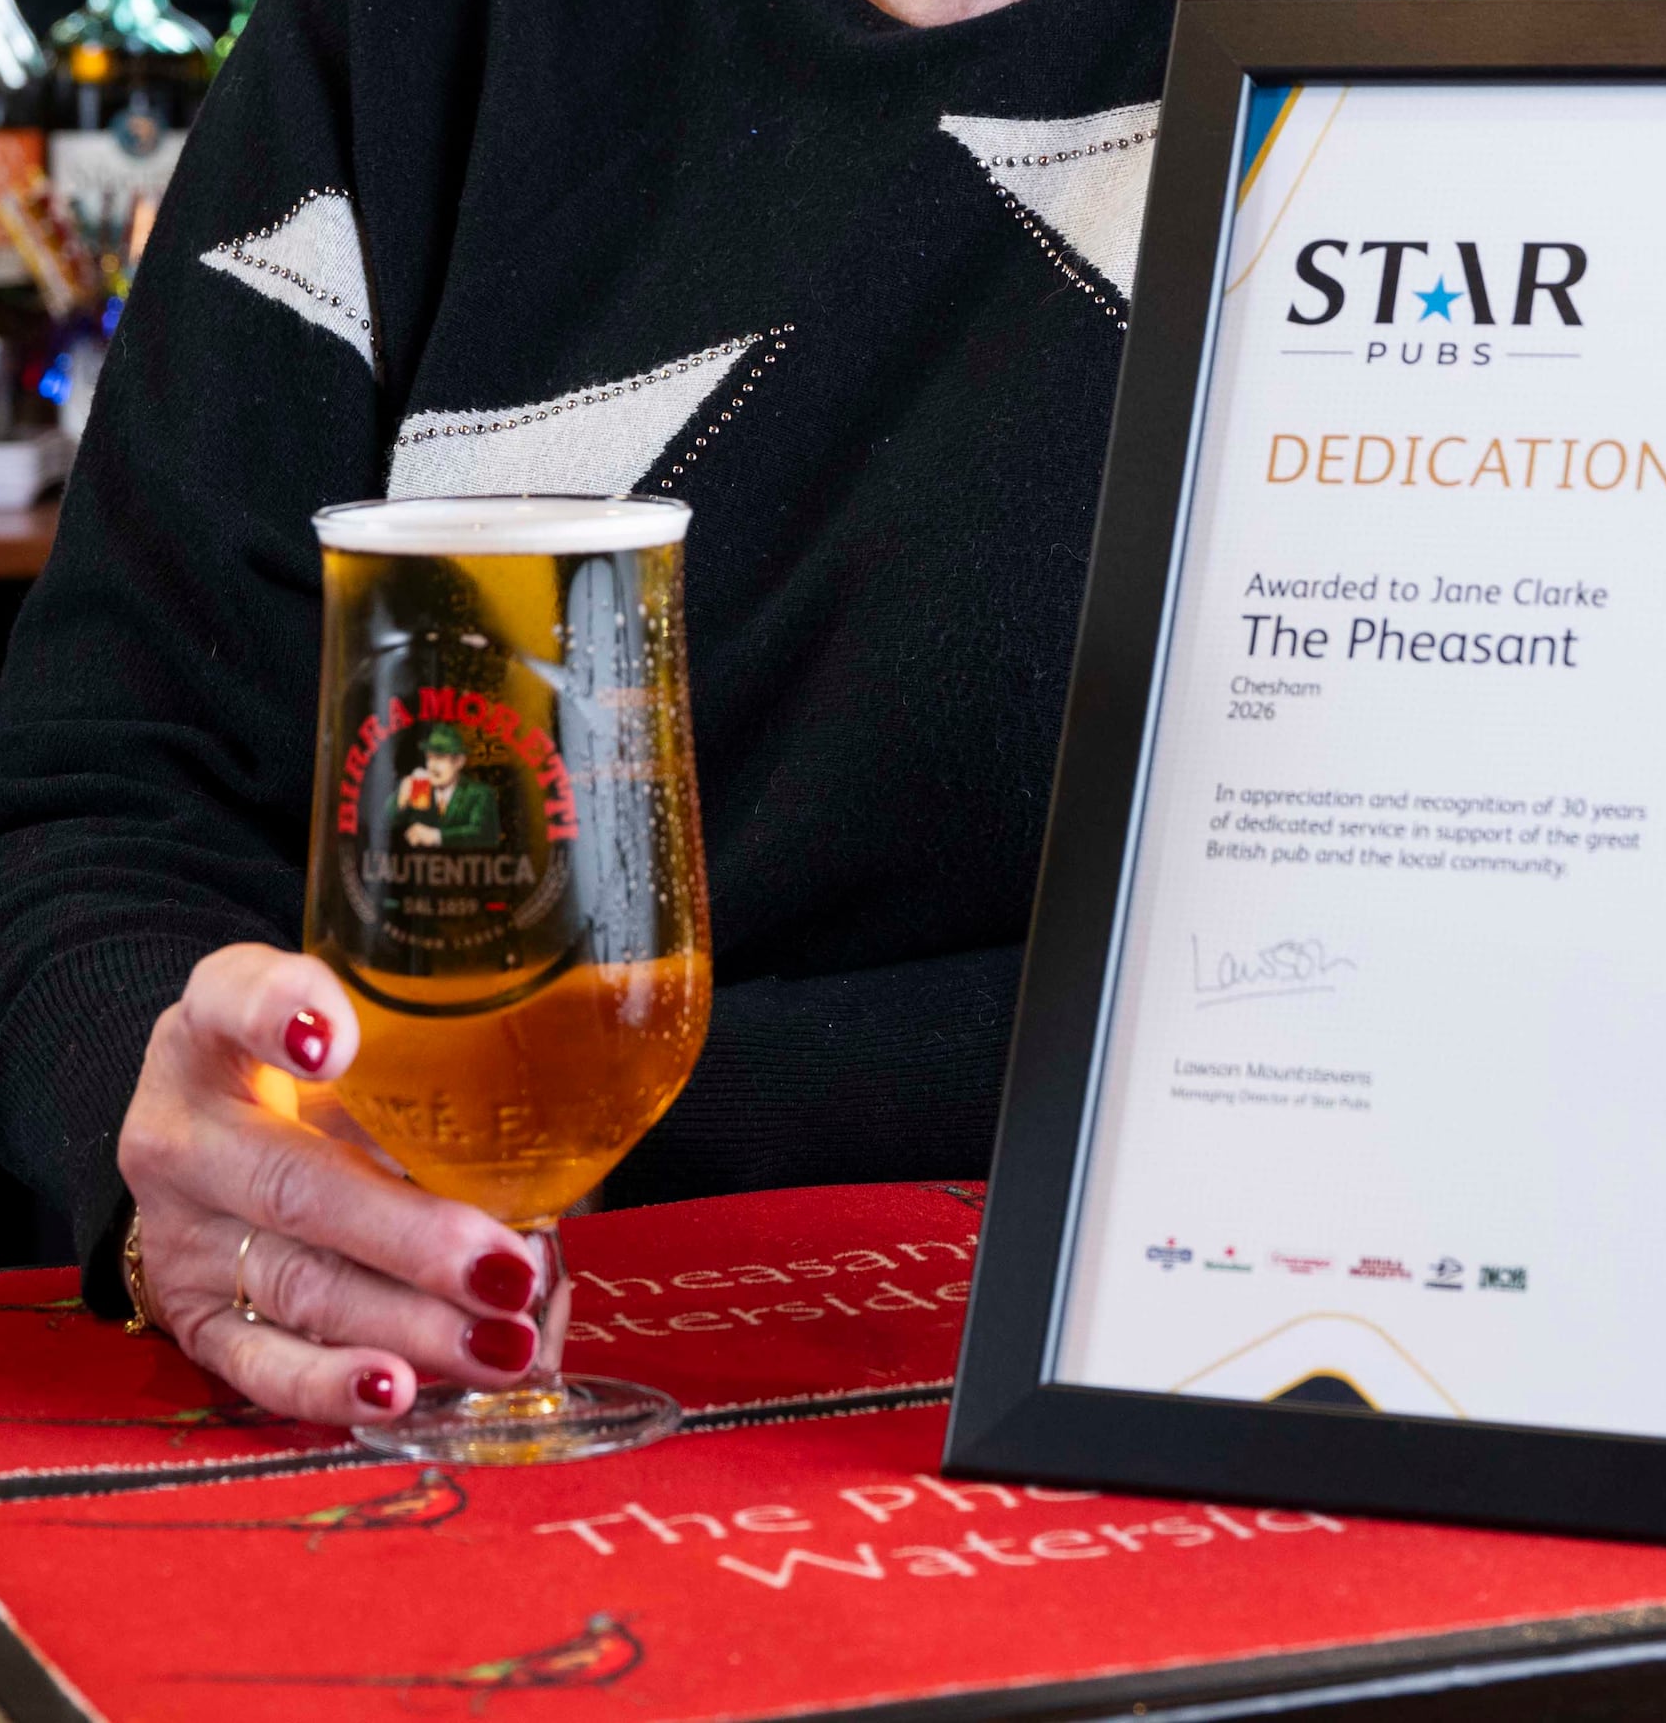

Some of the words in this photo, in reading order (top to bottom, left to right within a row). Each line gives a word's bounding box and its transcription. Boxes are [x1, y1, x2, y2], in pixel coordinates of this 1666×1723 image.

[1285, 238, 1589, 328] STAR
[1366, 340, 1492, 366] PUBS
[1244, 572, 1378, 602] Awarded
[1388, 575, 1420, 604] to
[1430, 576, 1502, 605] Jane
[1513, 578, 1609, 609] Clarke
[1241, 614, 1330, 660] The
[1347, 617, 1580, 668] Pheasant
[1230, 676, 1322, 698] Chesham
[1227, 700, 1276, 721] 2026
[337, 695, 415, 836] BIRRA
[418, 686, 579, 843] MORETTI
[1214, 783, 1235, 804] In
[1239, 786, 1364, 811] appreciation
[1369, 791, 1409, 811] and
[1413, 793, 1527, 819] recognition
[1532, 796, 1555, 817] of
[1560, 798, 1587, 820] 30
[1590, 802, 1647, 824] years
[1209, 811, 1233, 832] of
[1235, 814, 1334, 837] dedicated
[1338, 819, 1406, 839] service
[1411, 820, 1431, 840] in
[1435, 824, 1514, 848] support
[1519, 824, 1541, 845] of
[1545, 827, 1580, 848] the
[1584, 831, 1642, 854] great
[361, 852, 538, 887] L'AUTENTICA
[1205, 839, 1269, 862] British
[1271, 842, 1312, 866] pub
[1314, 845, 1355, 867] and
[1359, 847, 1394, 868] the
[1397, 849, 1446, 871] local
[1449, 853, 1569, 880] community.
[1173, 1057, 1242, 1079] Lawson
[569, 1233, 979, 1298] heasan
[564, 1280, 973, 1344] aterside
[533, 1500, 813, 1555] The
